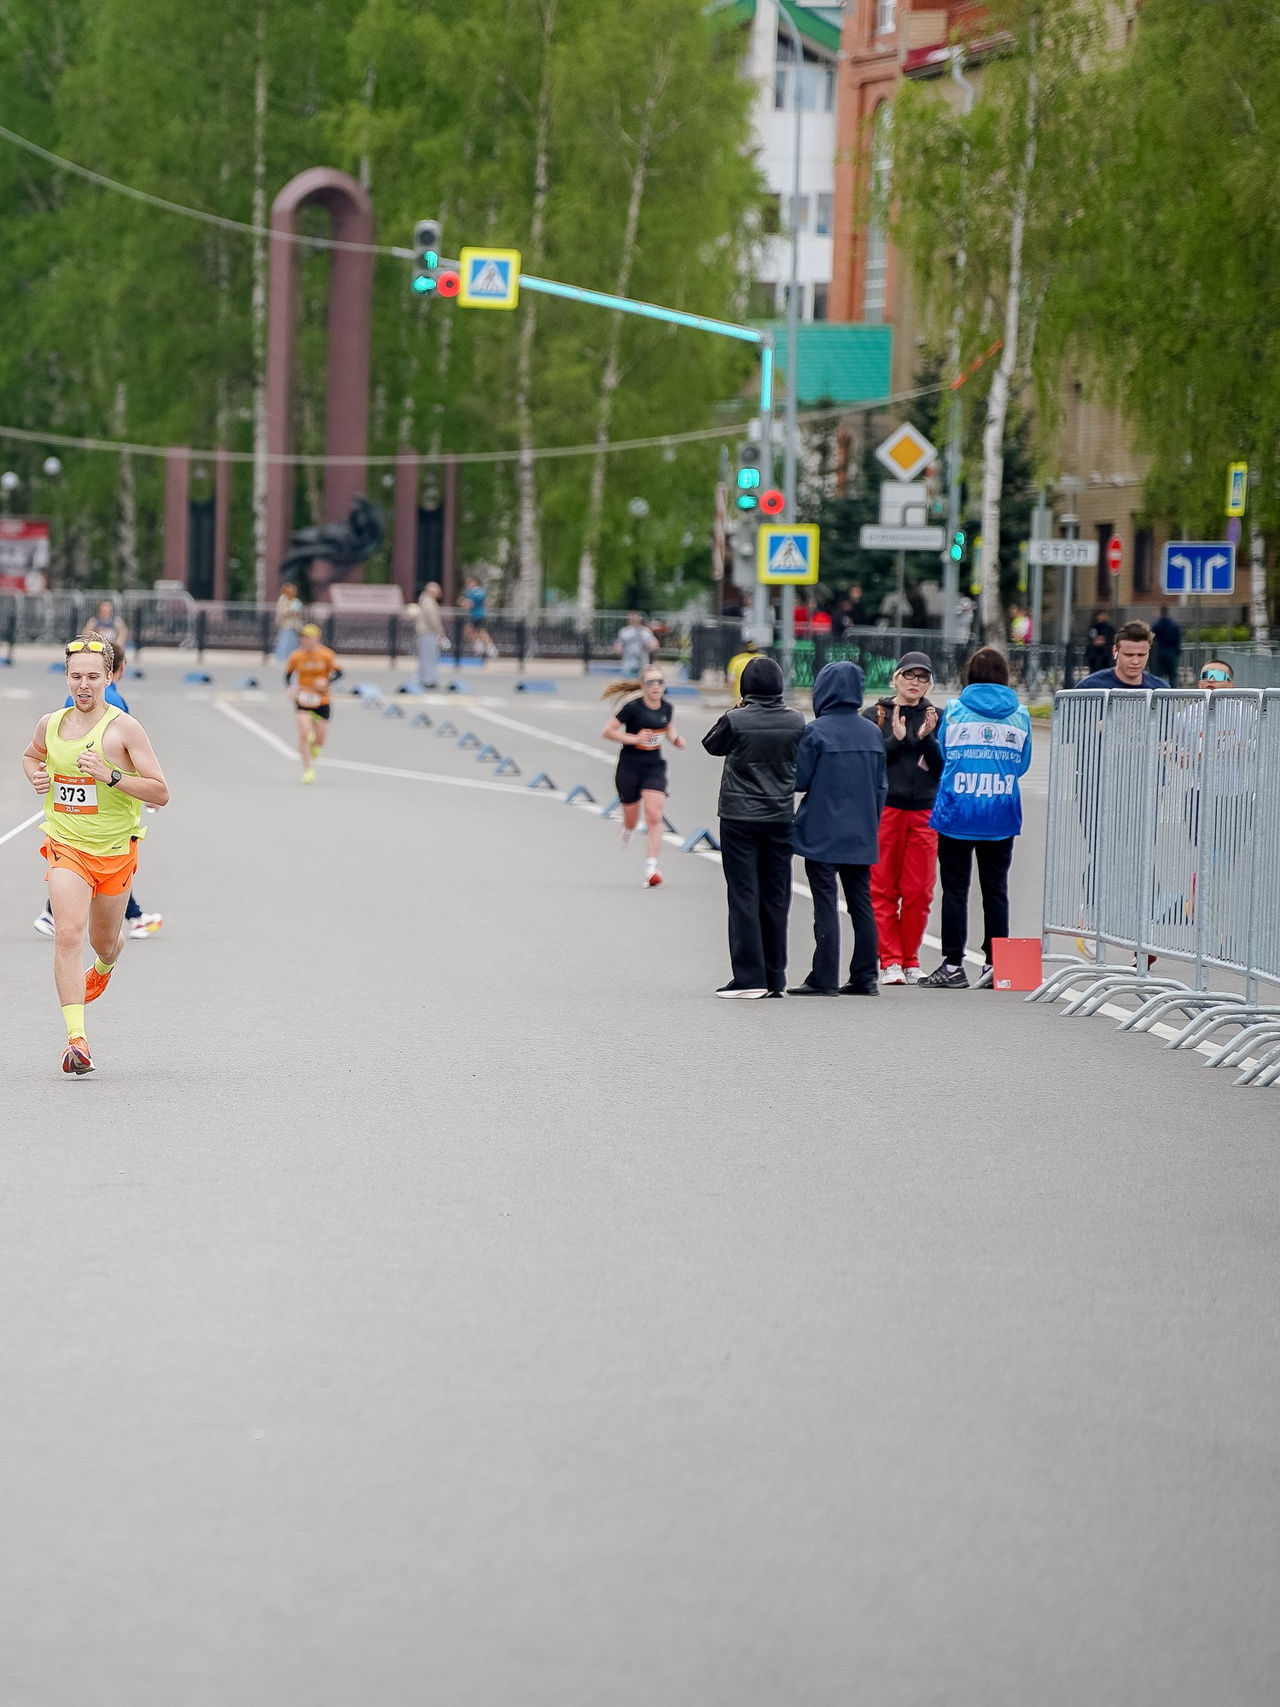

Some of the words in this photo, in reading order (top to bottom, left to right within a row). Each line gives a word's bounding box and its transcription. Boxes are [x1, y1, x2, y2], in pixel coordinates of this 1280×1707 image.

[1040, 543, 1088, 561] СТОП
[954, 772, 1016, 798] СУДЬЯ
[60, 786, 86, 803] 373
